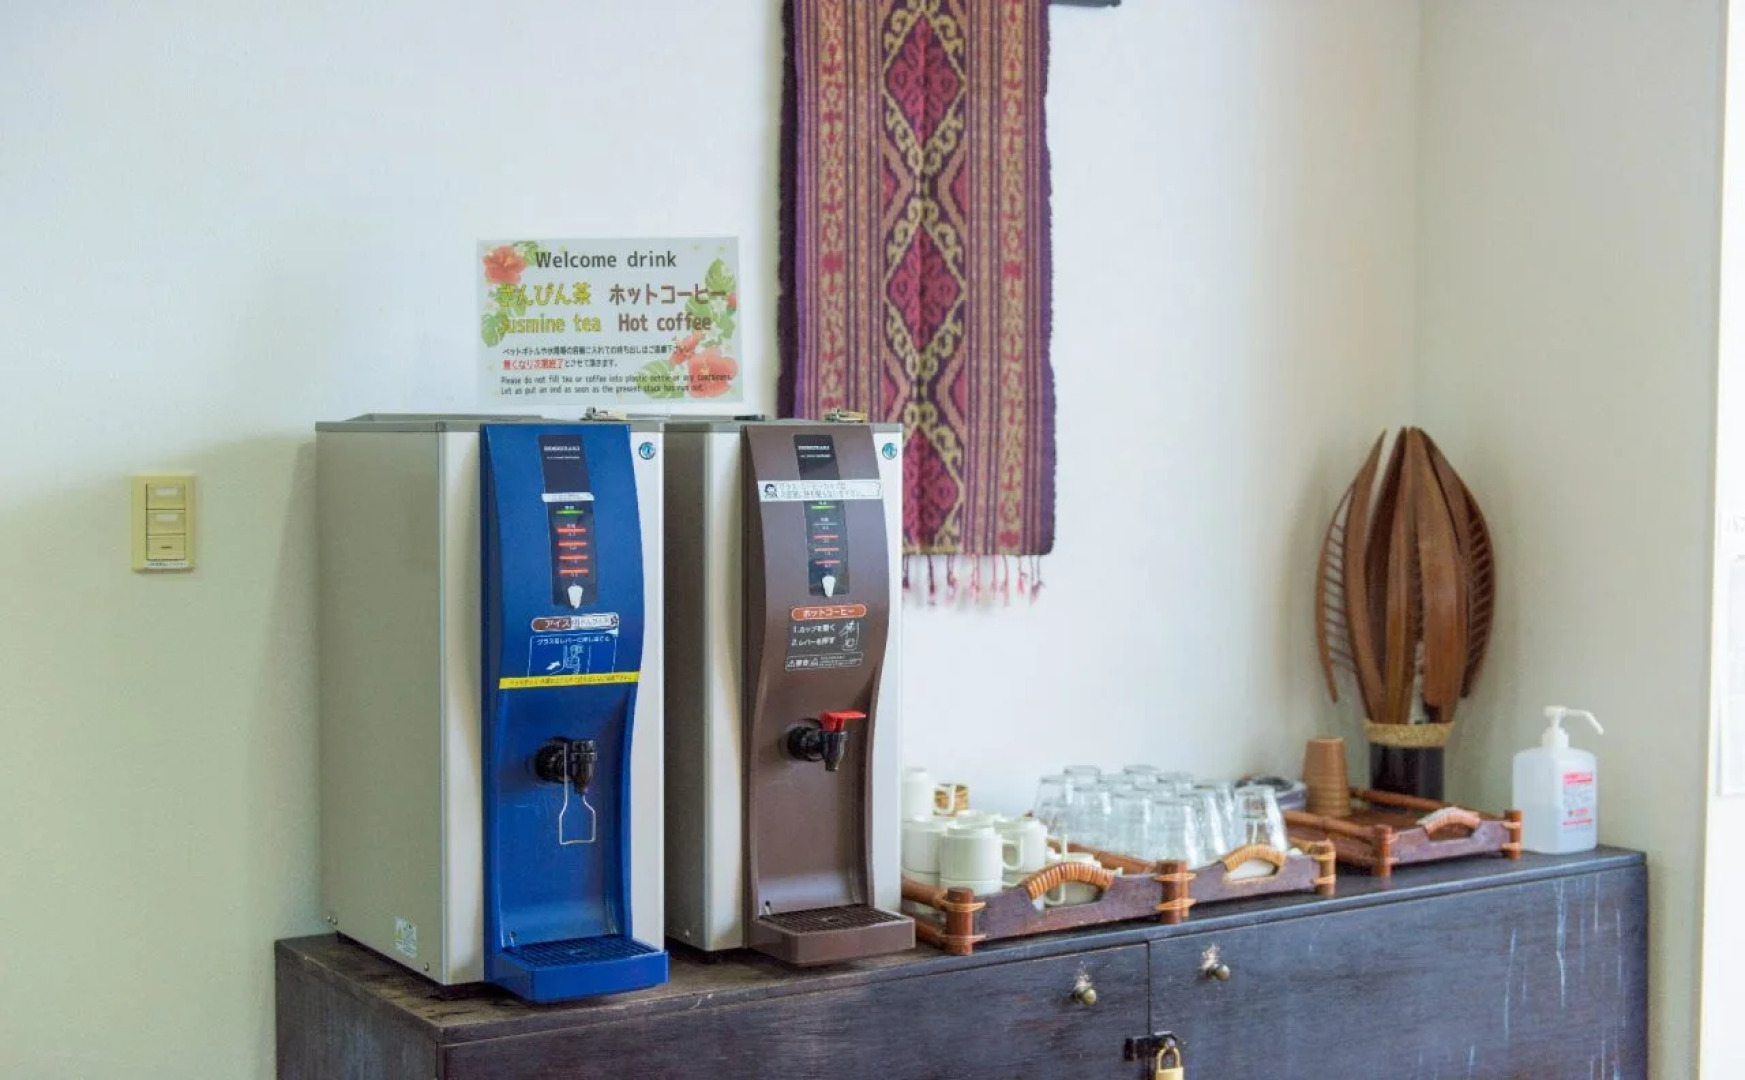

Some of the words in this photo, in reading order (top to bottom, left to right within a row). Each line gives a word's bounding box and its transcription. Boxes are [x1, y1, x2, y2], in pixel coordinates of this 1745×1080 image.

[536, 251, 617, 268] Welcome
[627, 250, 677, 267] drink
[608, 283, 727, 306] ホットコーヒー
[573, 312, 601, 332] tea
[618, 312, 648, 332] Hot
[656, 311, 711, 331] coffee
[501, 375, 521, 385] Please
[534, 376, 546, 384] not
[548, 374, 559, 383] fill
[585, 374, 606, 383] coffee
[574, 386, 590, 394] soon
[602, 385, 613, 394] the
[802, 608, 855, 618] ホットコーヒー
